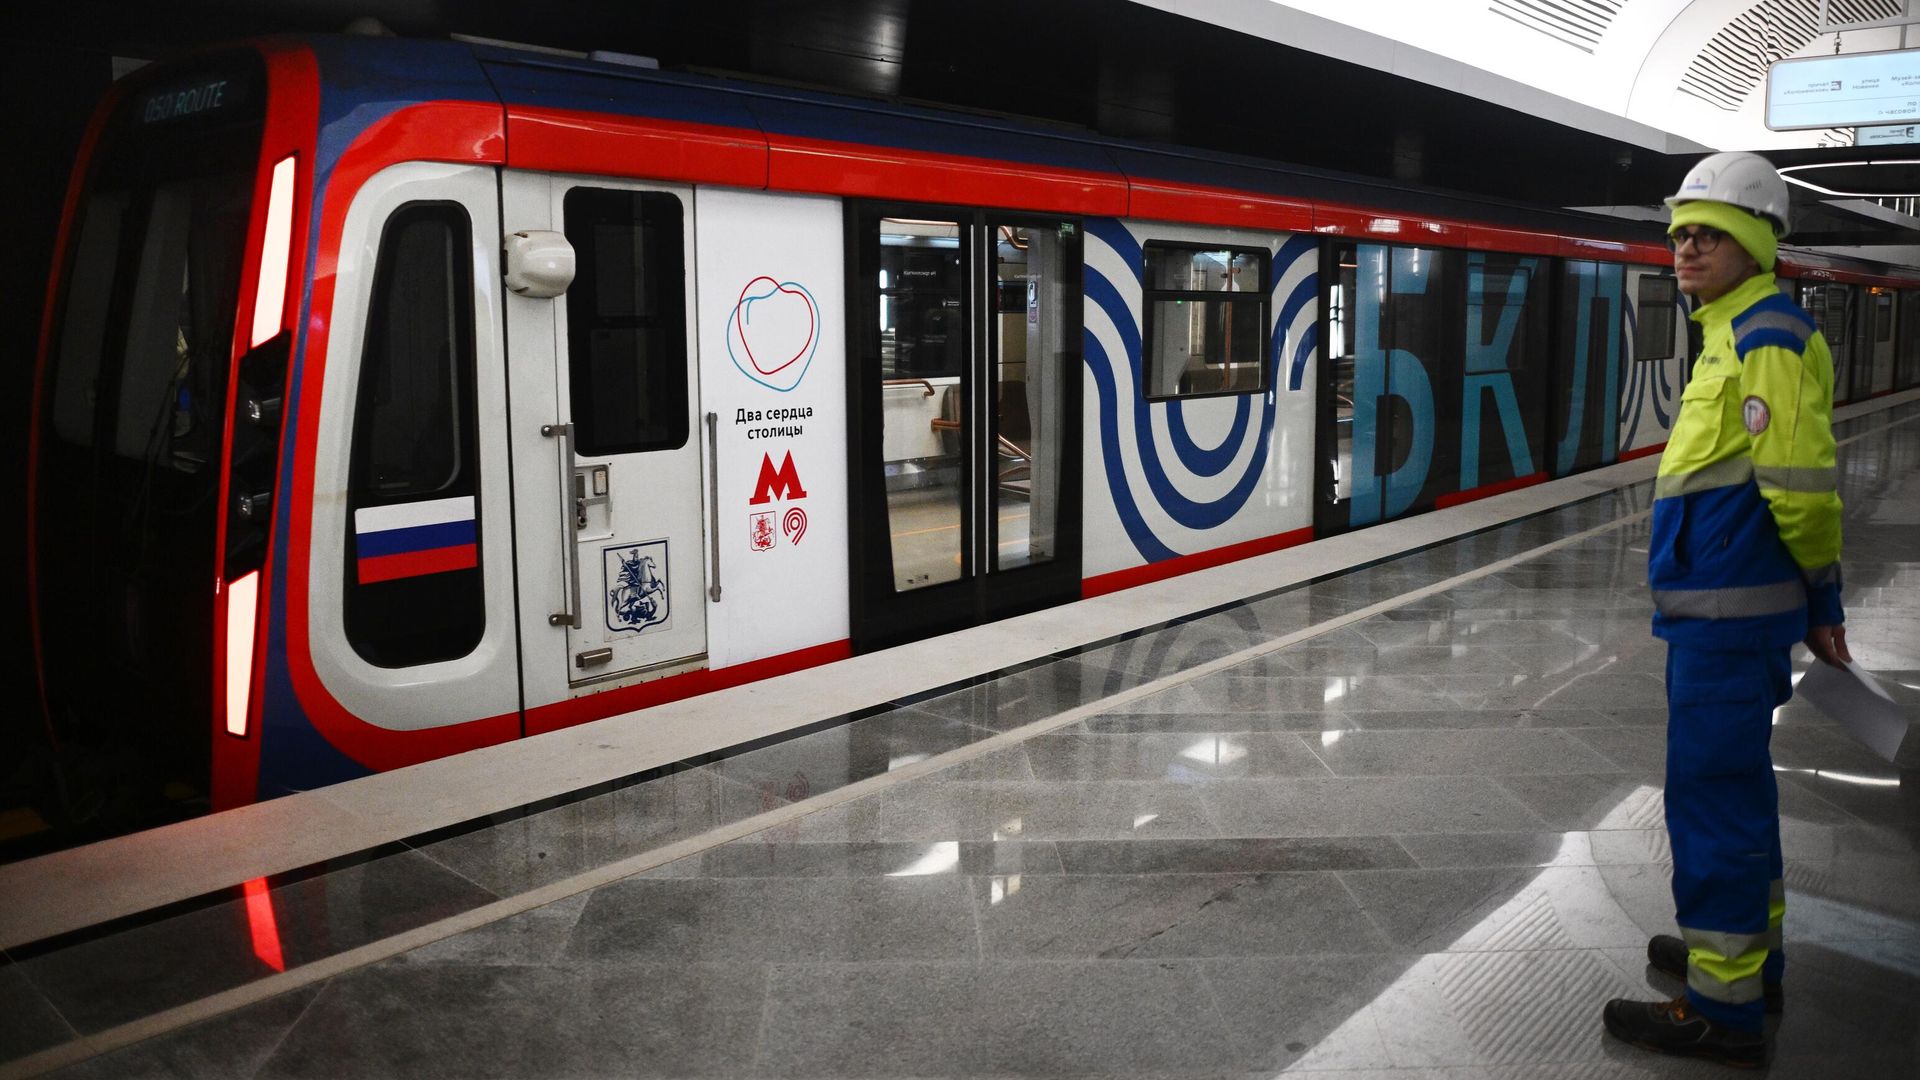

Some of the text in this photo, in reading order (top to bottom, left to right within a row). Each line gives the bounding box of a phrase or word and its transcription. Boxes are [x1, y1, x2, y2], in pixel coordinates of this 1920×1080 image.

[175, 80, 227, 115] ROUTE
[1350, 244, 1624, 527] БКЛ
[735, 406, 813, 425] Два сердца
[747, 425, 803, 440] столицы
